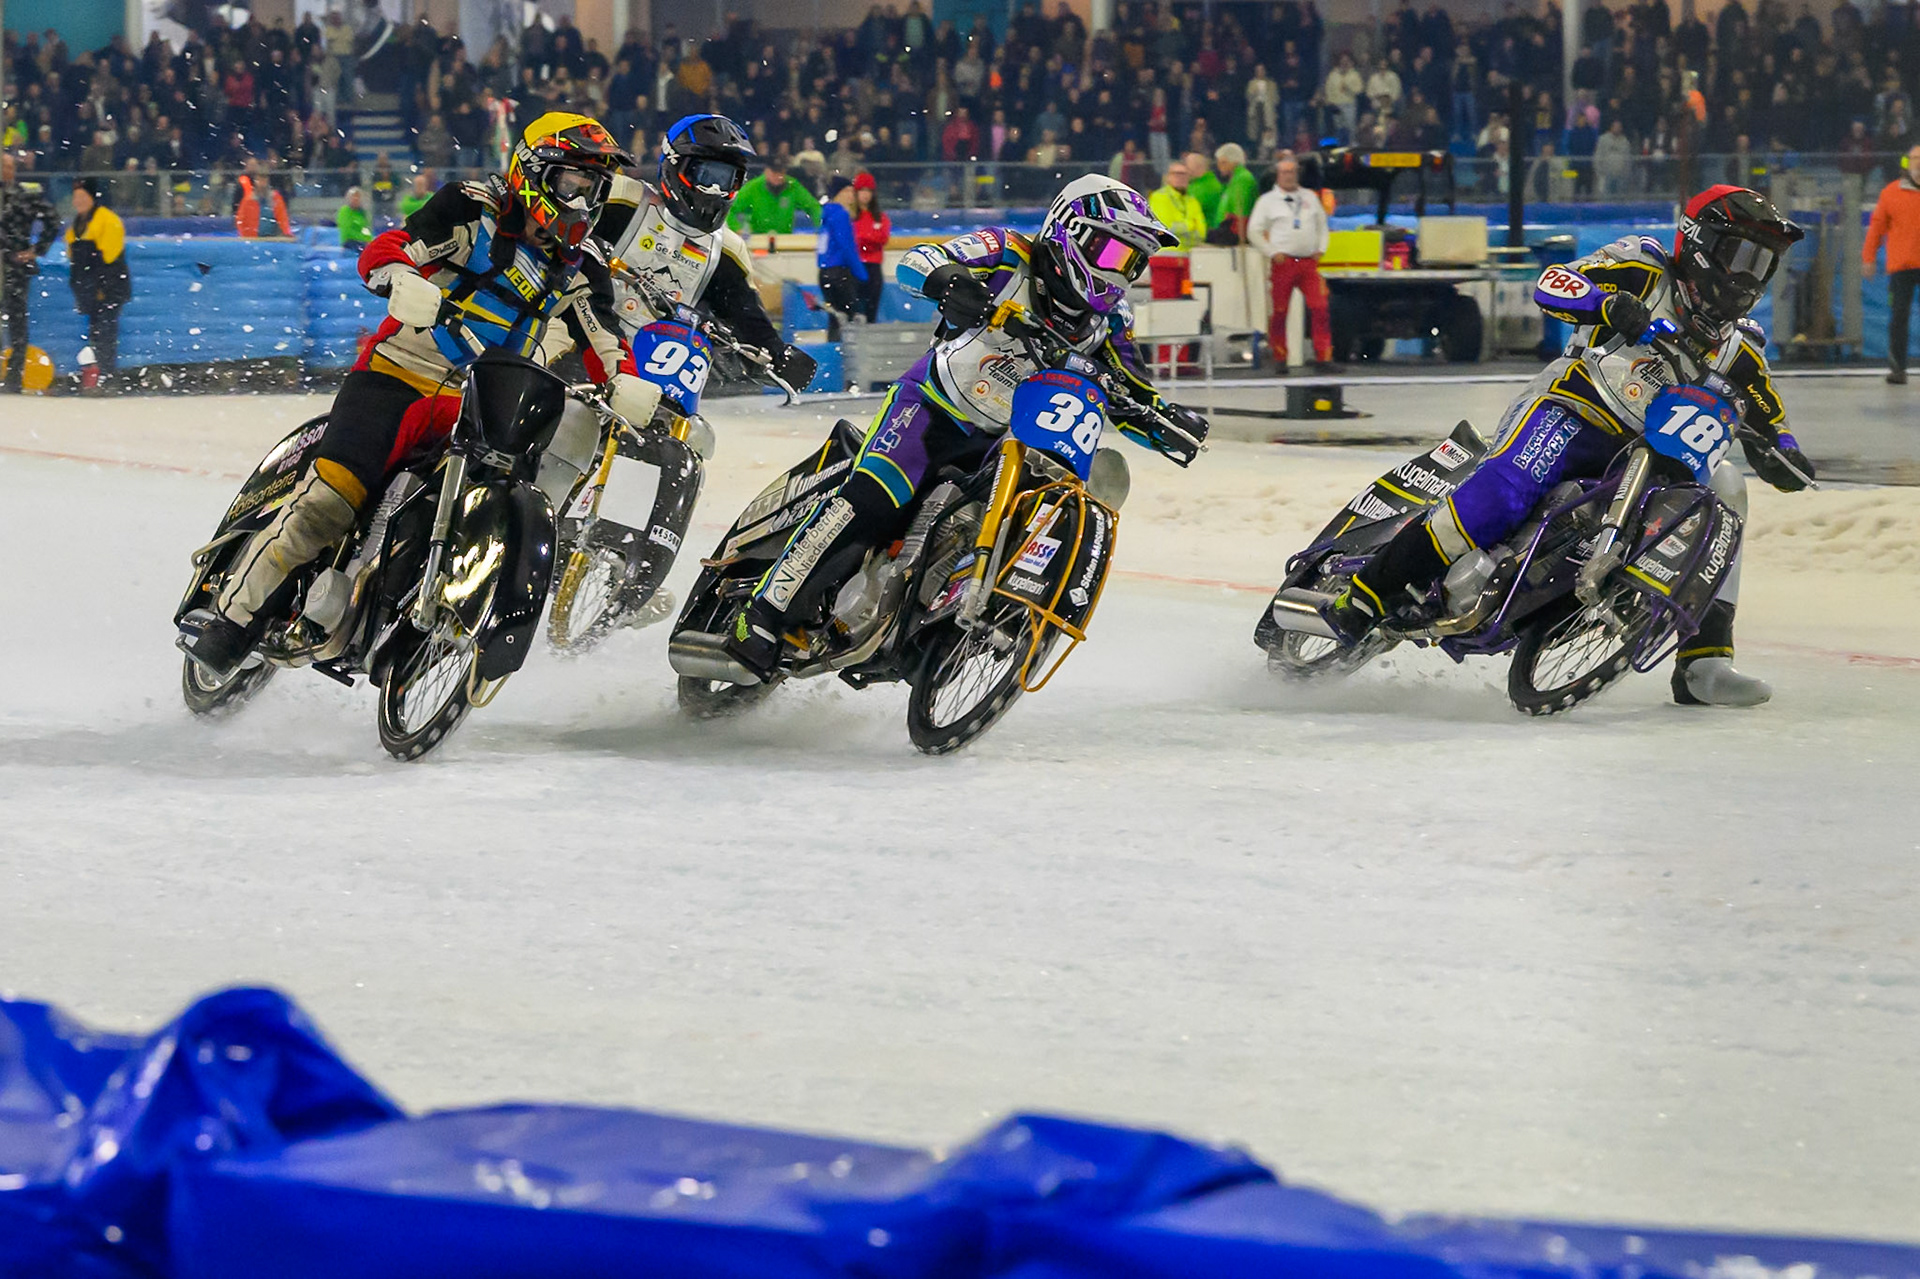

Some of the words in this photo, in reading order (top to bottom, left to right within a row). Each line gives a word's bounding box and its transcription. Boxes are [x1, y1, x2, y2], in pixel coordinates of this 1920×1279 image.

[1540, 270, 1585, 298] PBR
[582, 306, 598, 334] WACO
[644, 340, 709, 394] 93
[1746, 383, 1771, 414] WACO
[1036, 392, 1102, 455] 38
[1053, 440, 1077, 459] FIM
[785, 497, 846, 571] Malerbetrieb
[796, 506, 854, 578] Niedermaier
[1635, 551, 1675, 582] kugelmann
[1007, 571, 1046, 595] kugelmann
